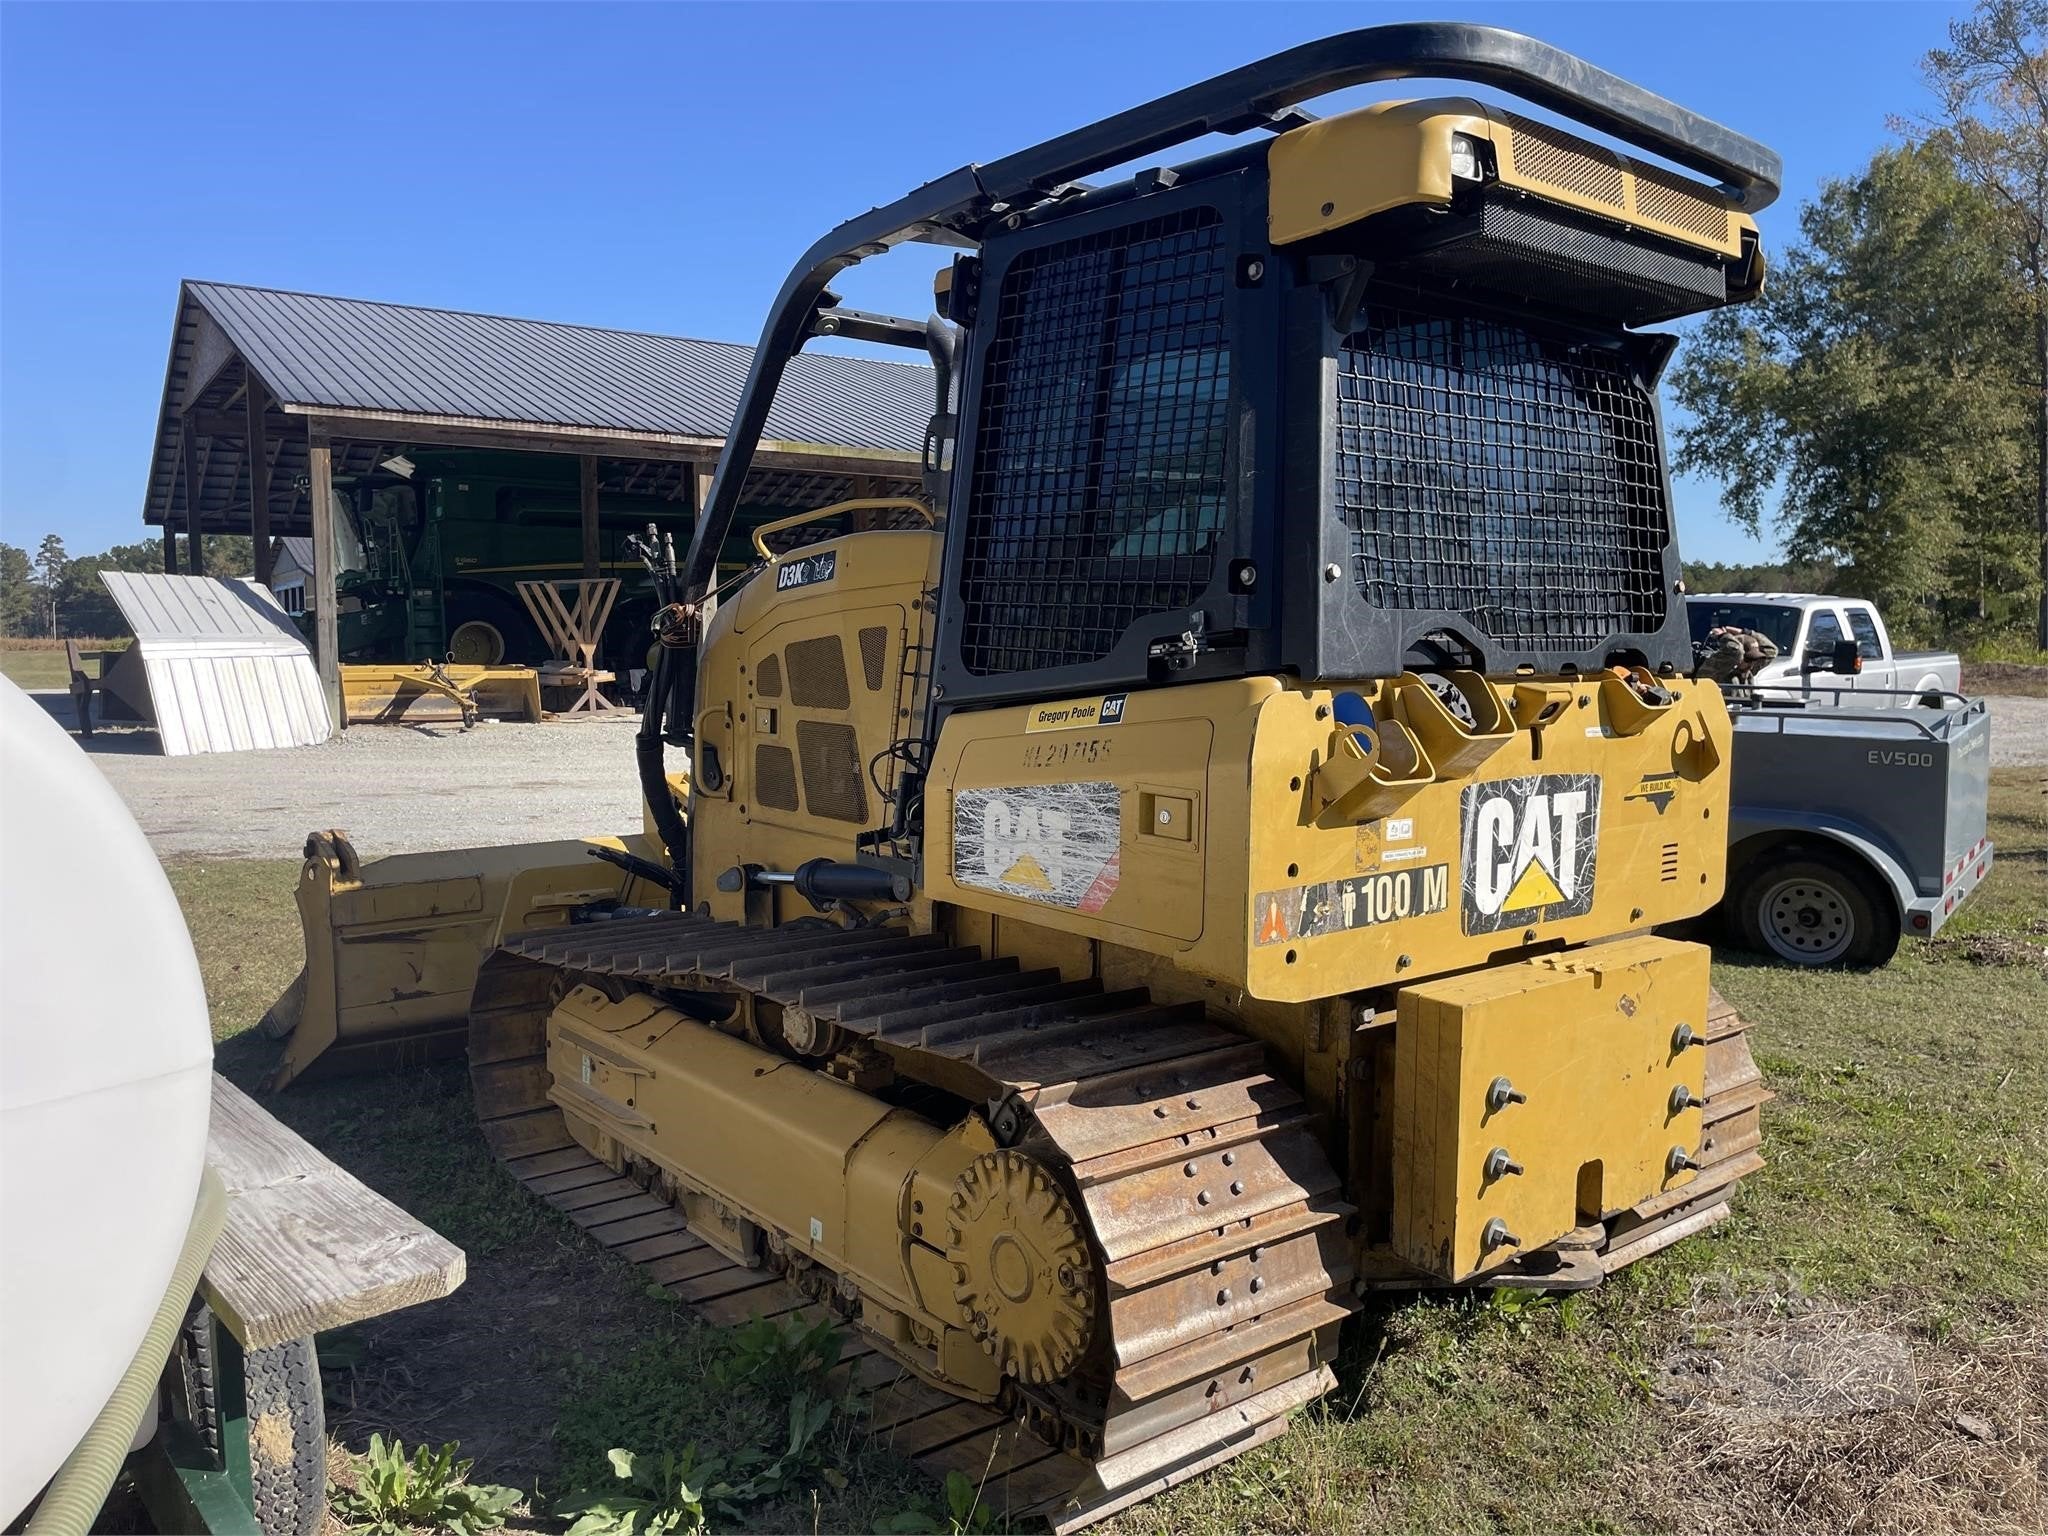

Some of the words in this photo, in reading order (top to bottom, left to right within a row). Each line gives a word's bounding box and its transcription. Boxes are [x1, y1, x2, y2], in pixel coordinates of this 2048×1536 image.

[1038, 709, 1070, 723] Gregory
[1071, 705, 1096, 720] Poole
[1101, 699, 1123, 717] CAT
[1867, 750, 1933, 767] EV500
[1640, 783, 1649, 793] WE
[1650, 781, 1664, 792] BUILD
[983, 799, 1072, 888] CAT
[1475, 791, 1587, 916] CAT
[1361, 871, 1411, 923] 100
[1423, 865, 1448, 912] M
